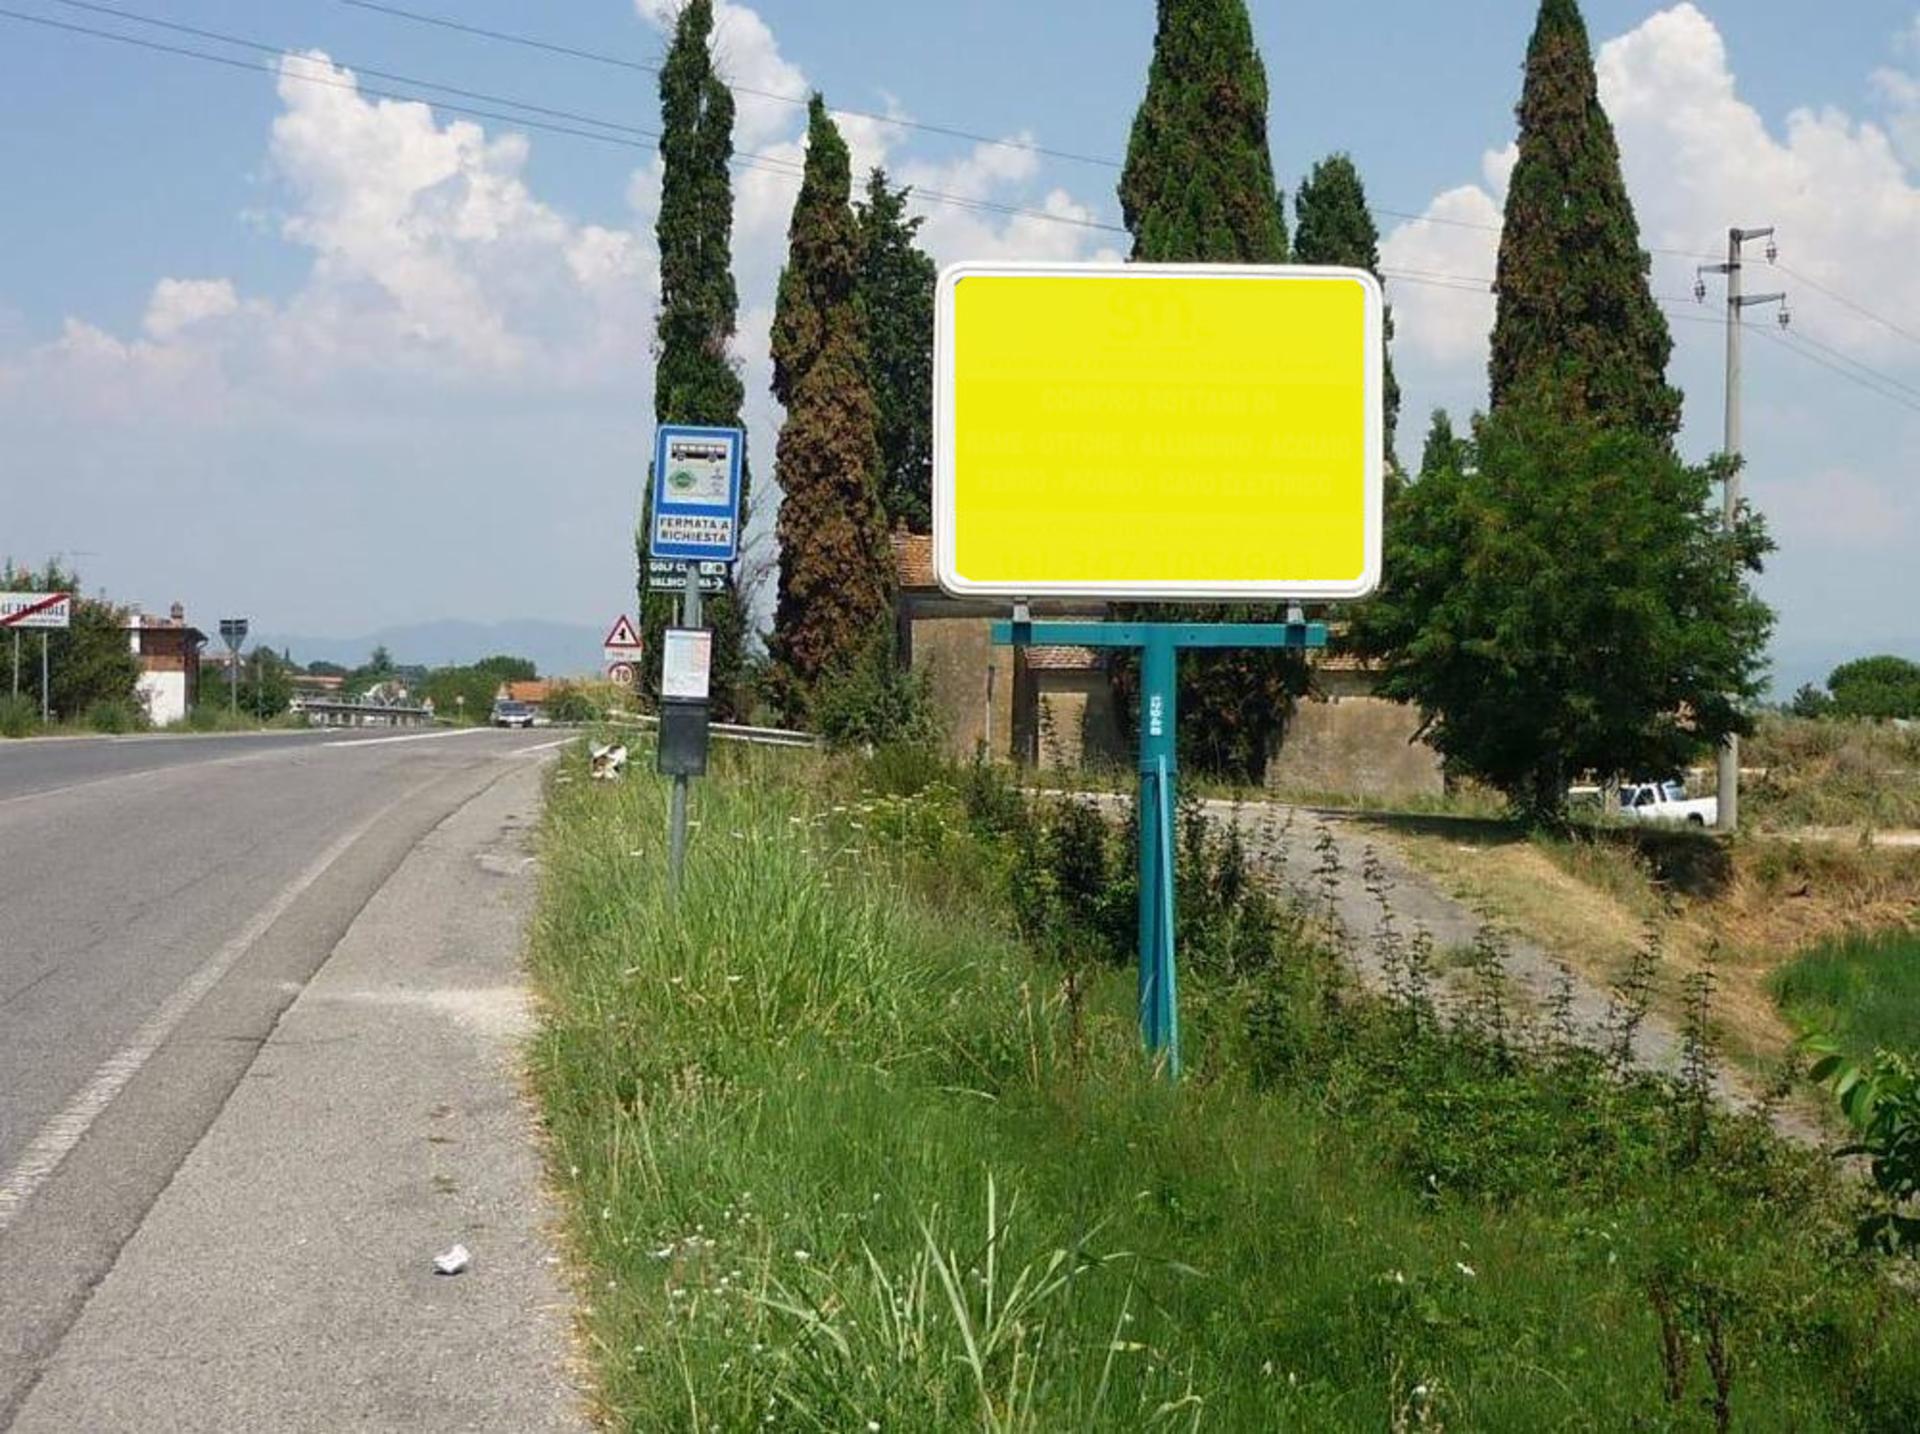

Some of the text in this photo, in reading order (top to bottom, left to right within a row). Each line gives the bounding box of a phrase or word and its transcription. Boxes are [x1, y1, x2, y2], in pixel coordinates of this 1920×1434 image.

[660, 518, 729, 529] FERMATA A
[660, 530, 727, 543] RICHIESTA
